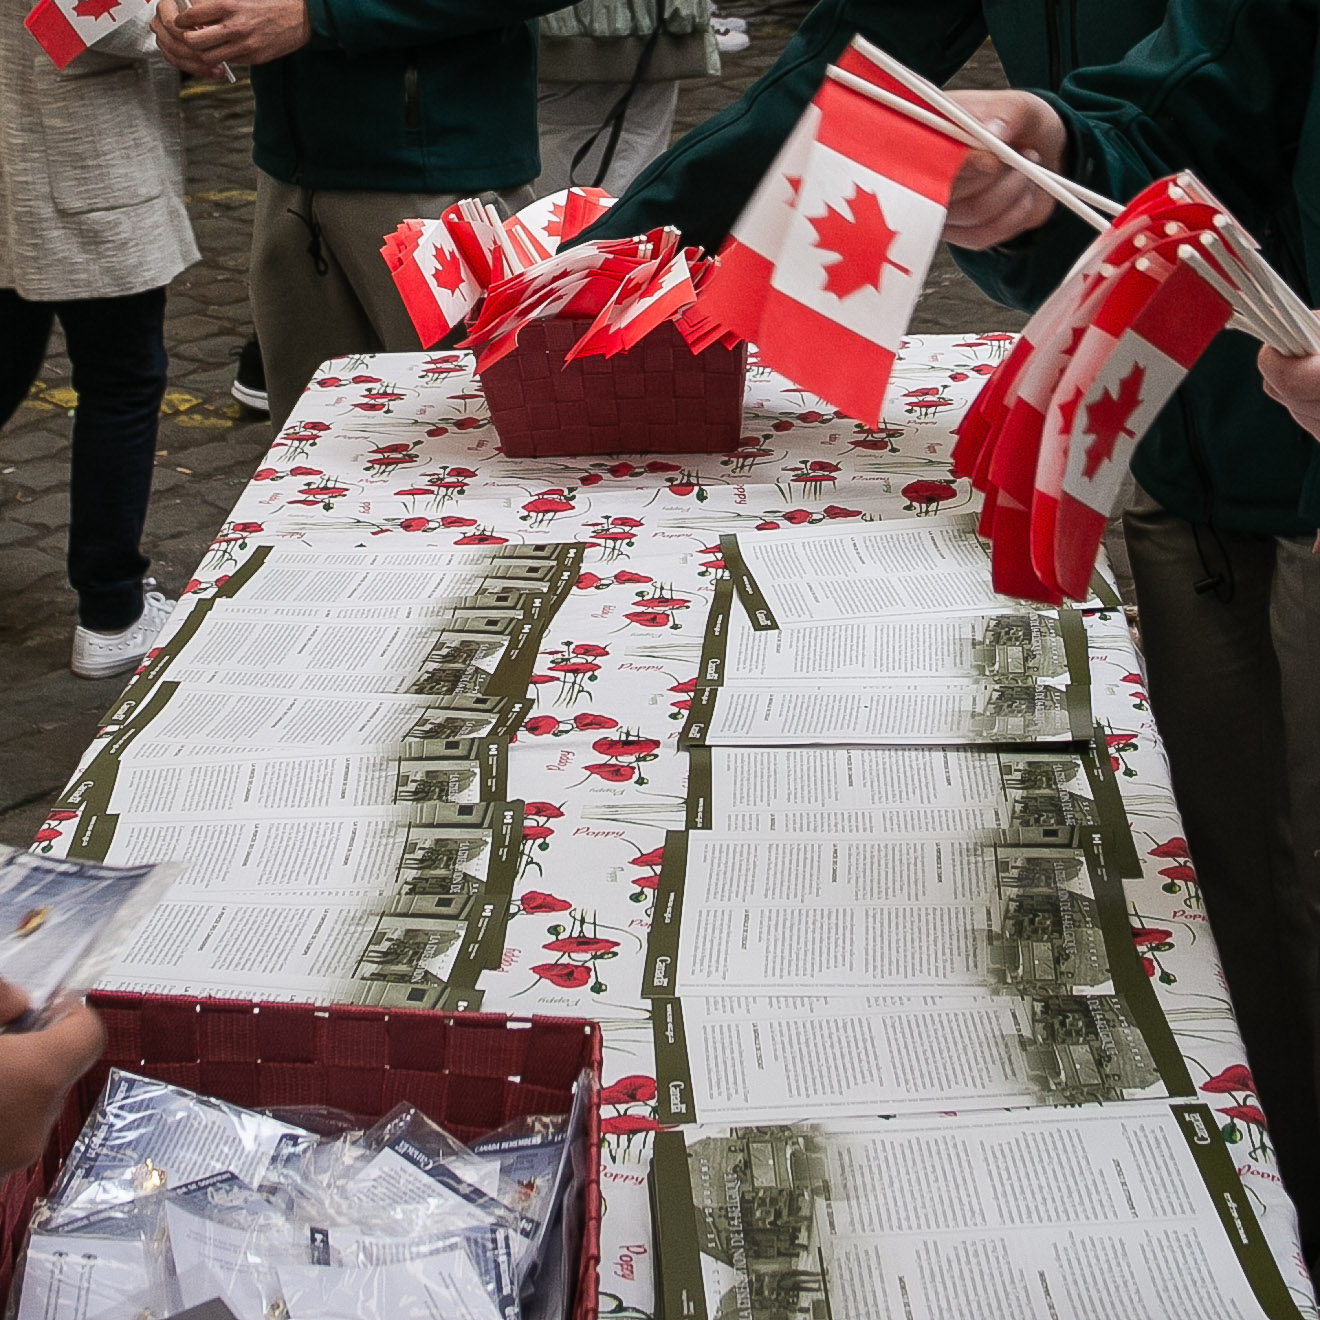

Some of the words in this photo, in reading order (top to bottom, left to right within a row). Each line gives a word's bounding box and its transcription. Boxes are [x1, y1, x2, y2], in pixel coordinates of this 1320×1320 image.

[651, 530, 695, 541] Poppy
[592, 603, 617, 620] Poppy
[617, 662, 665, 673] Poppy
[545, 750, 576, 772] Poppy
[588, 787, 627, 798] Poppy
[572, 826, 627, 839] Poppy
[653, 955, 671, 987] Canada
[537, 995, 583, 1009] Poppy
[669, 1081, 687, 1115] Canada
[394, 1139, 434, 1171] Canada
[474, 1141, 500, 1154] CANADA
[598, 1164, 646, 1187] Poppy
